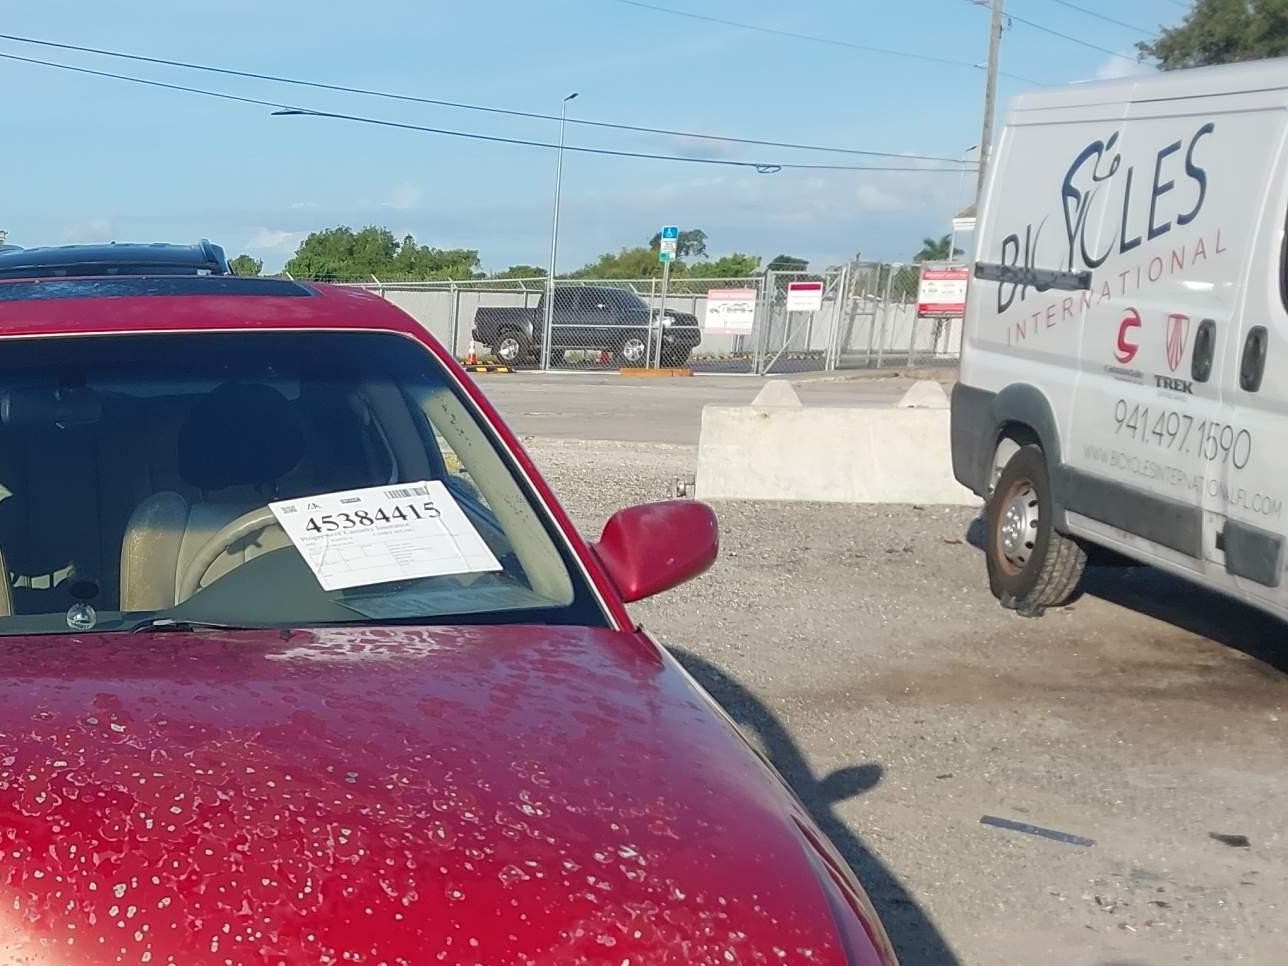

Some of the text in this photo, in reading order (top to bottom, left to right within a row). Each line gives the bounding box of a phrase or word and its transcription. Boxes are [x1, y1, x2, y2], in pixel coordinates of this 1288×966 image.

[997, 122, 1216, 314] BICYCLES
[1007, 229, 1228, 347] INTERNATIONAL
[1154, 374, 1194, 395] TREK
[1114, 399, 1252, 470] 941.497.1590
[305, 501, 441, 533] 45384415
